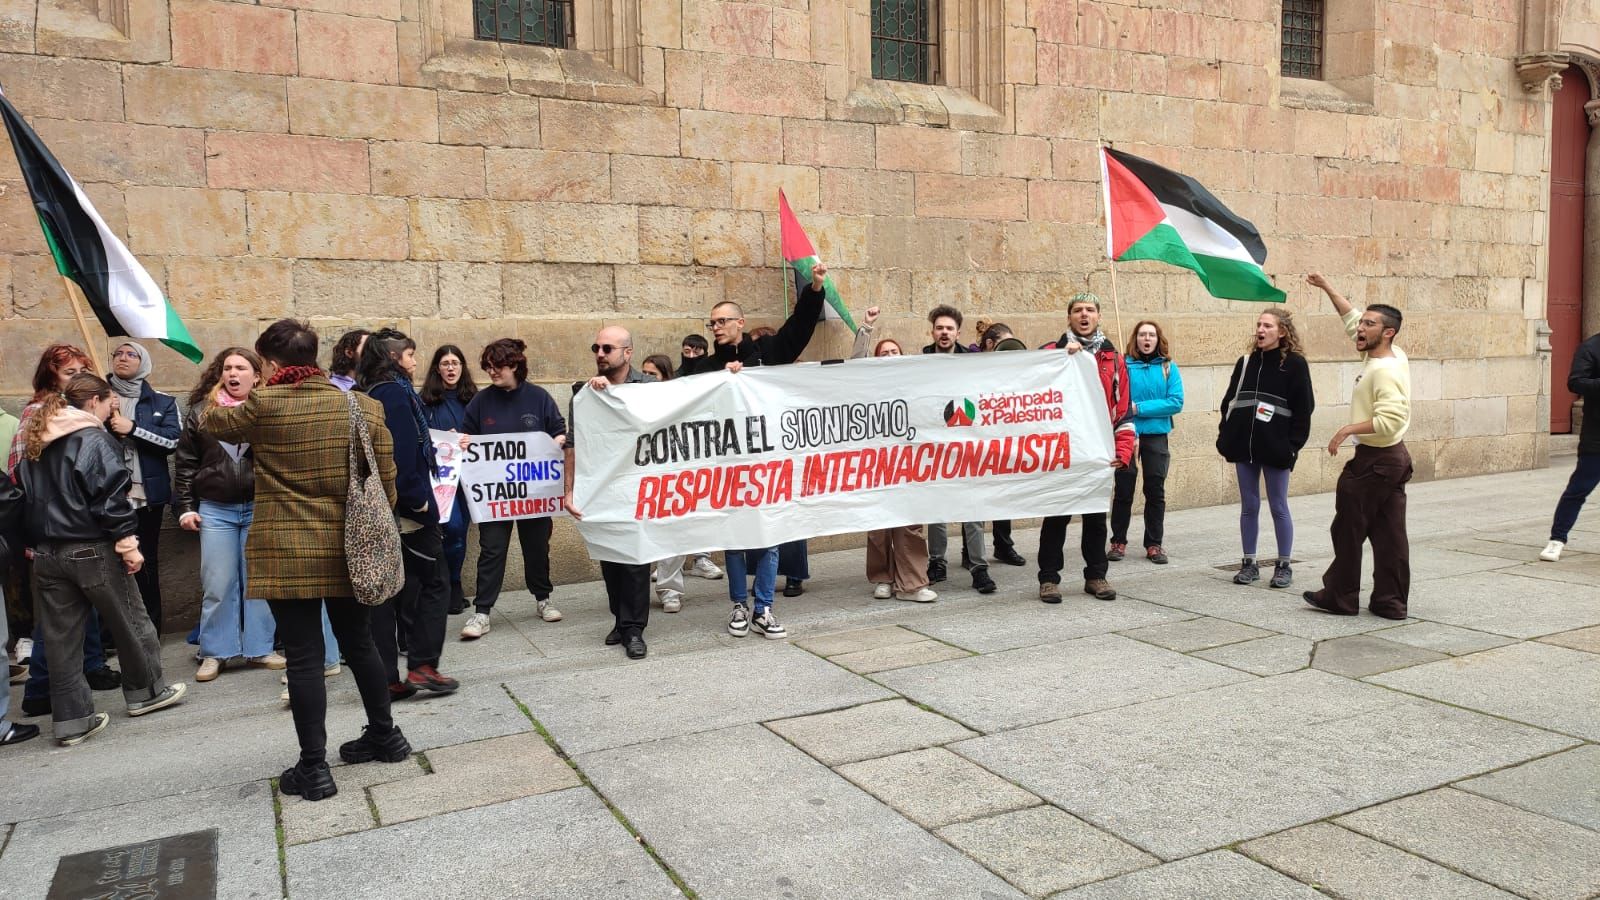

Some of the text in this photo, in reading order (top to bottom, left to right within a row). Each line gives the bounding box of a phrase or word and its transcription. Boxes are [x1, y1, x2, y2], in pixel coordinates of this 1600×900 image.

[978, 388, 1063, 411] acampada
[634, 399, 916, 466] CONTRA EL SIONISMO,
[462, 440, 527, 463] STADO
[634, 431, 1070, 520] RESPUESTA INTERNACIONALISTA
[466, 481, 528, 503] STADO
